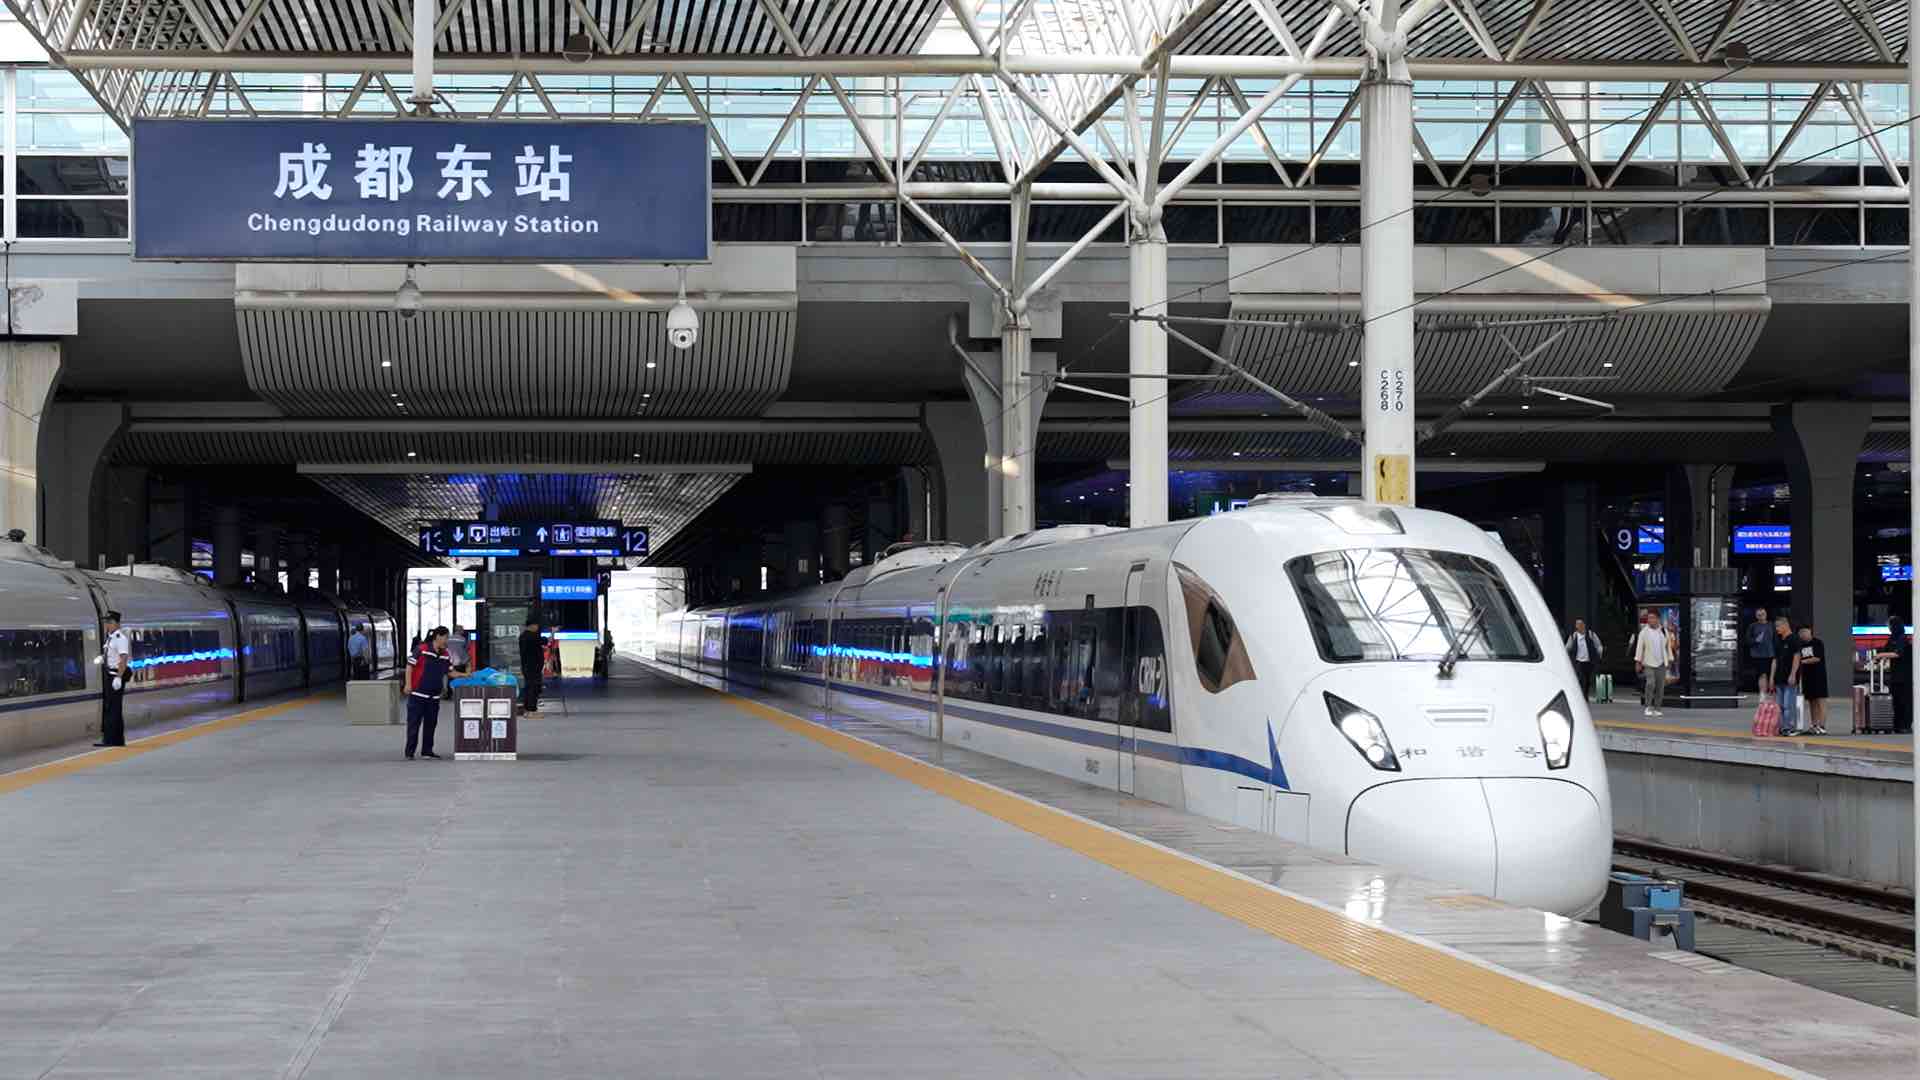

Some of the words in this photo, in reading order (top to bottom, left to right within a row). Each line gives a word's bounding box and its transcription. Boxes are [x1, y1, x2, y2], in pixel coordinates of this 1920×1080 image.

[273, 142, 573, 201] 成都东站
[247, 213, 411, 236] Chengdudong
[416, 214, 508, 237] Railway
[514, 214, 600, 233] Station
[1380, 369, 1389, 412] C268
[1395, 369, 1404, 412] C270
[489, 526, 521, 537] 出站口
[622, 531, 647, 552] 12
[1617, 529, 1632, 550] 9
[1399, 744, 1542, 759] 和谐号
